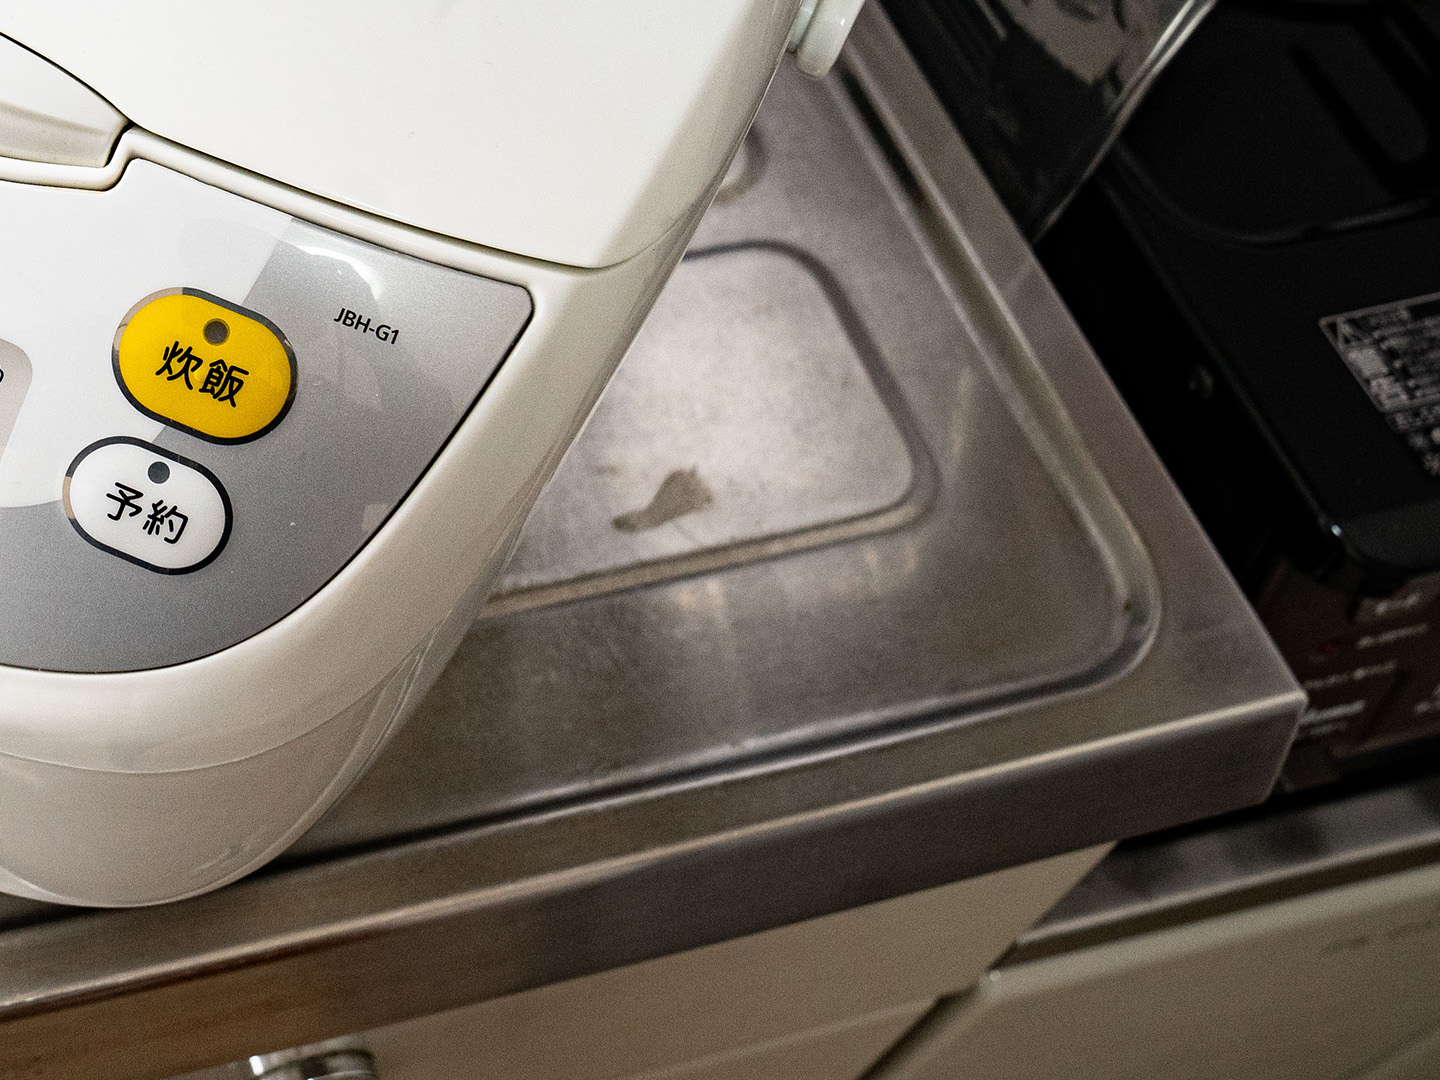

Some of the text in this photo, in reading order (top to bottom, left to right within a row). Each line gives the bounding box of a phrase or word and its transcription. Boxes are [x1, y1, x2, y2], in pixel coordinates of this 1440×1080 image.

[333, 307, 401, 345] JBH-G1
[155, 340, 250, 408] 炊飯
[105, 481, 189, 545] 予約
